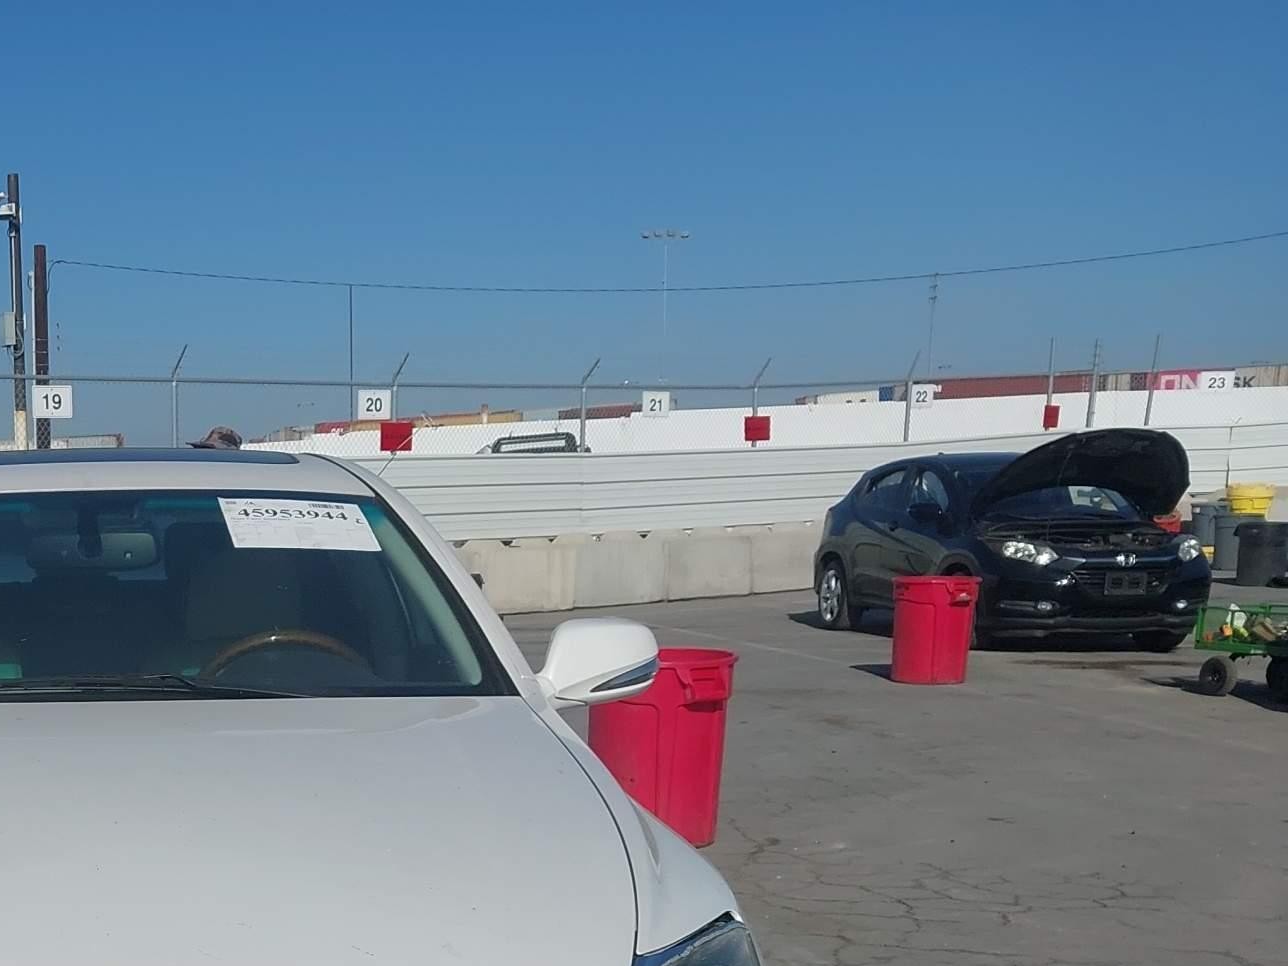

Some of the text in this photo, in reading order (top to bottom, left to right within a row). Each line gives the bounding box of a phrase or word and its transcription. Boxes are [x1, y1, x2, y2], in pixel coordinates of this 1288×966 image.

[1208, 377, 1226, 389] 23
[42, 393, 62, 410] 19
[915, 390, 928, 403] 22
[365, 397, 383, 413] 20
[649, 398, 662, 412] 21
[238, 508, 348, 521] 45953944
